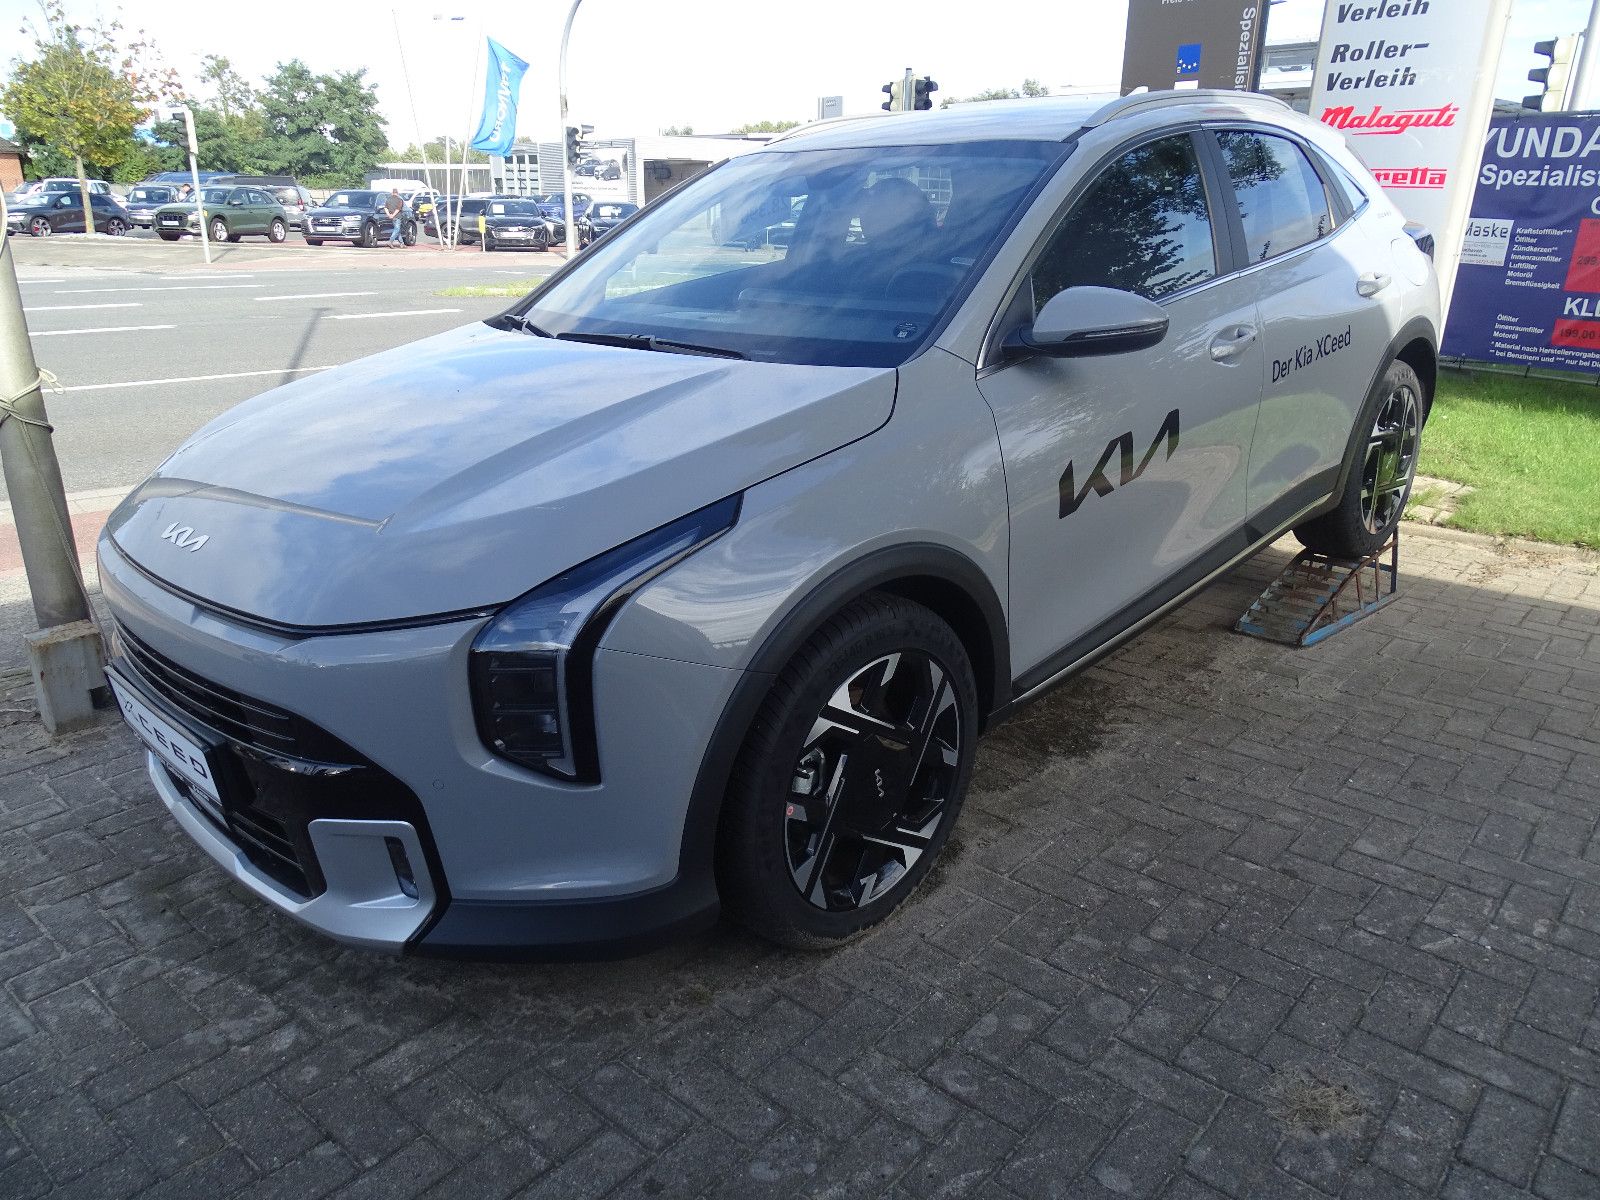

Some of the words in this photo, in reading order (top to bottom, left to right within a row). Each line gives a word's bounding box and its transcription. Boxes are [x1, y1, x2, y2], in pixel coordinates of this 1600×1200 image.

[1337, 0, 1430, 24] Verleih
[1330, 40, 1430, 64] Roller-
[1326, 66, 1417, 92] Verleih
[1320, 101, 1460, 136] Malaguti
[1506, 270, 1533, 279] Motoröl
[1509, 261, 1538, 270] Luftfilter
[1504, 278, 1560, 290] Bremsflüssigkeit
[1492, 331, 1519, 340] Motoröl
[1494, 341, 1521, 351] Material
[1271, 357, 1293, 384] Der
[1295, 345, 1313, 369] Kia
[1315, 324, 1352, 360] XCeed
[1540, 355, 1555, 363] und
[1058, 408, 1181, 520] KIA
[161, 521, 211, 553] KIA
